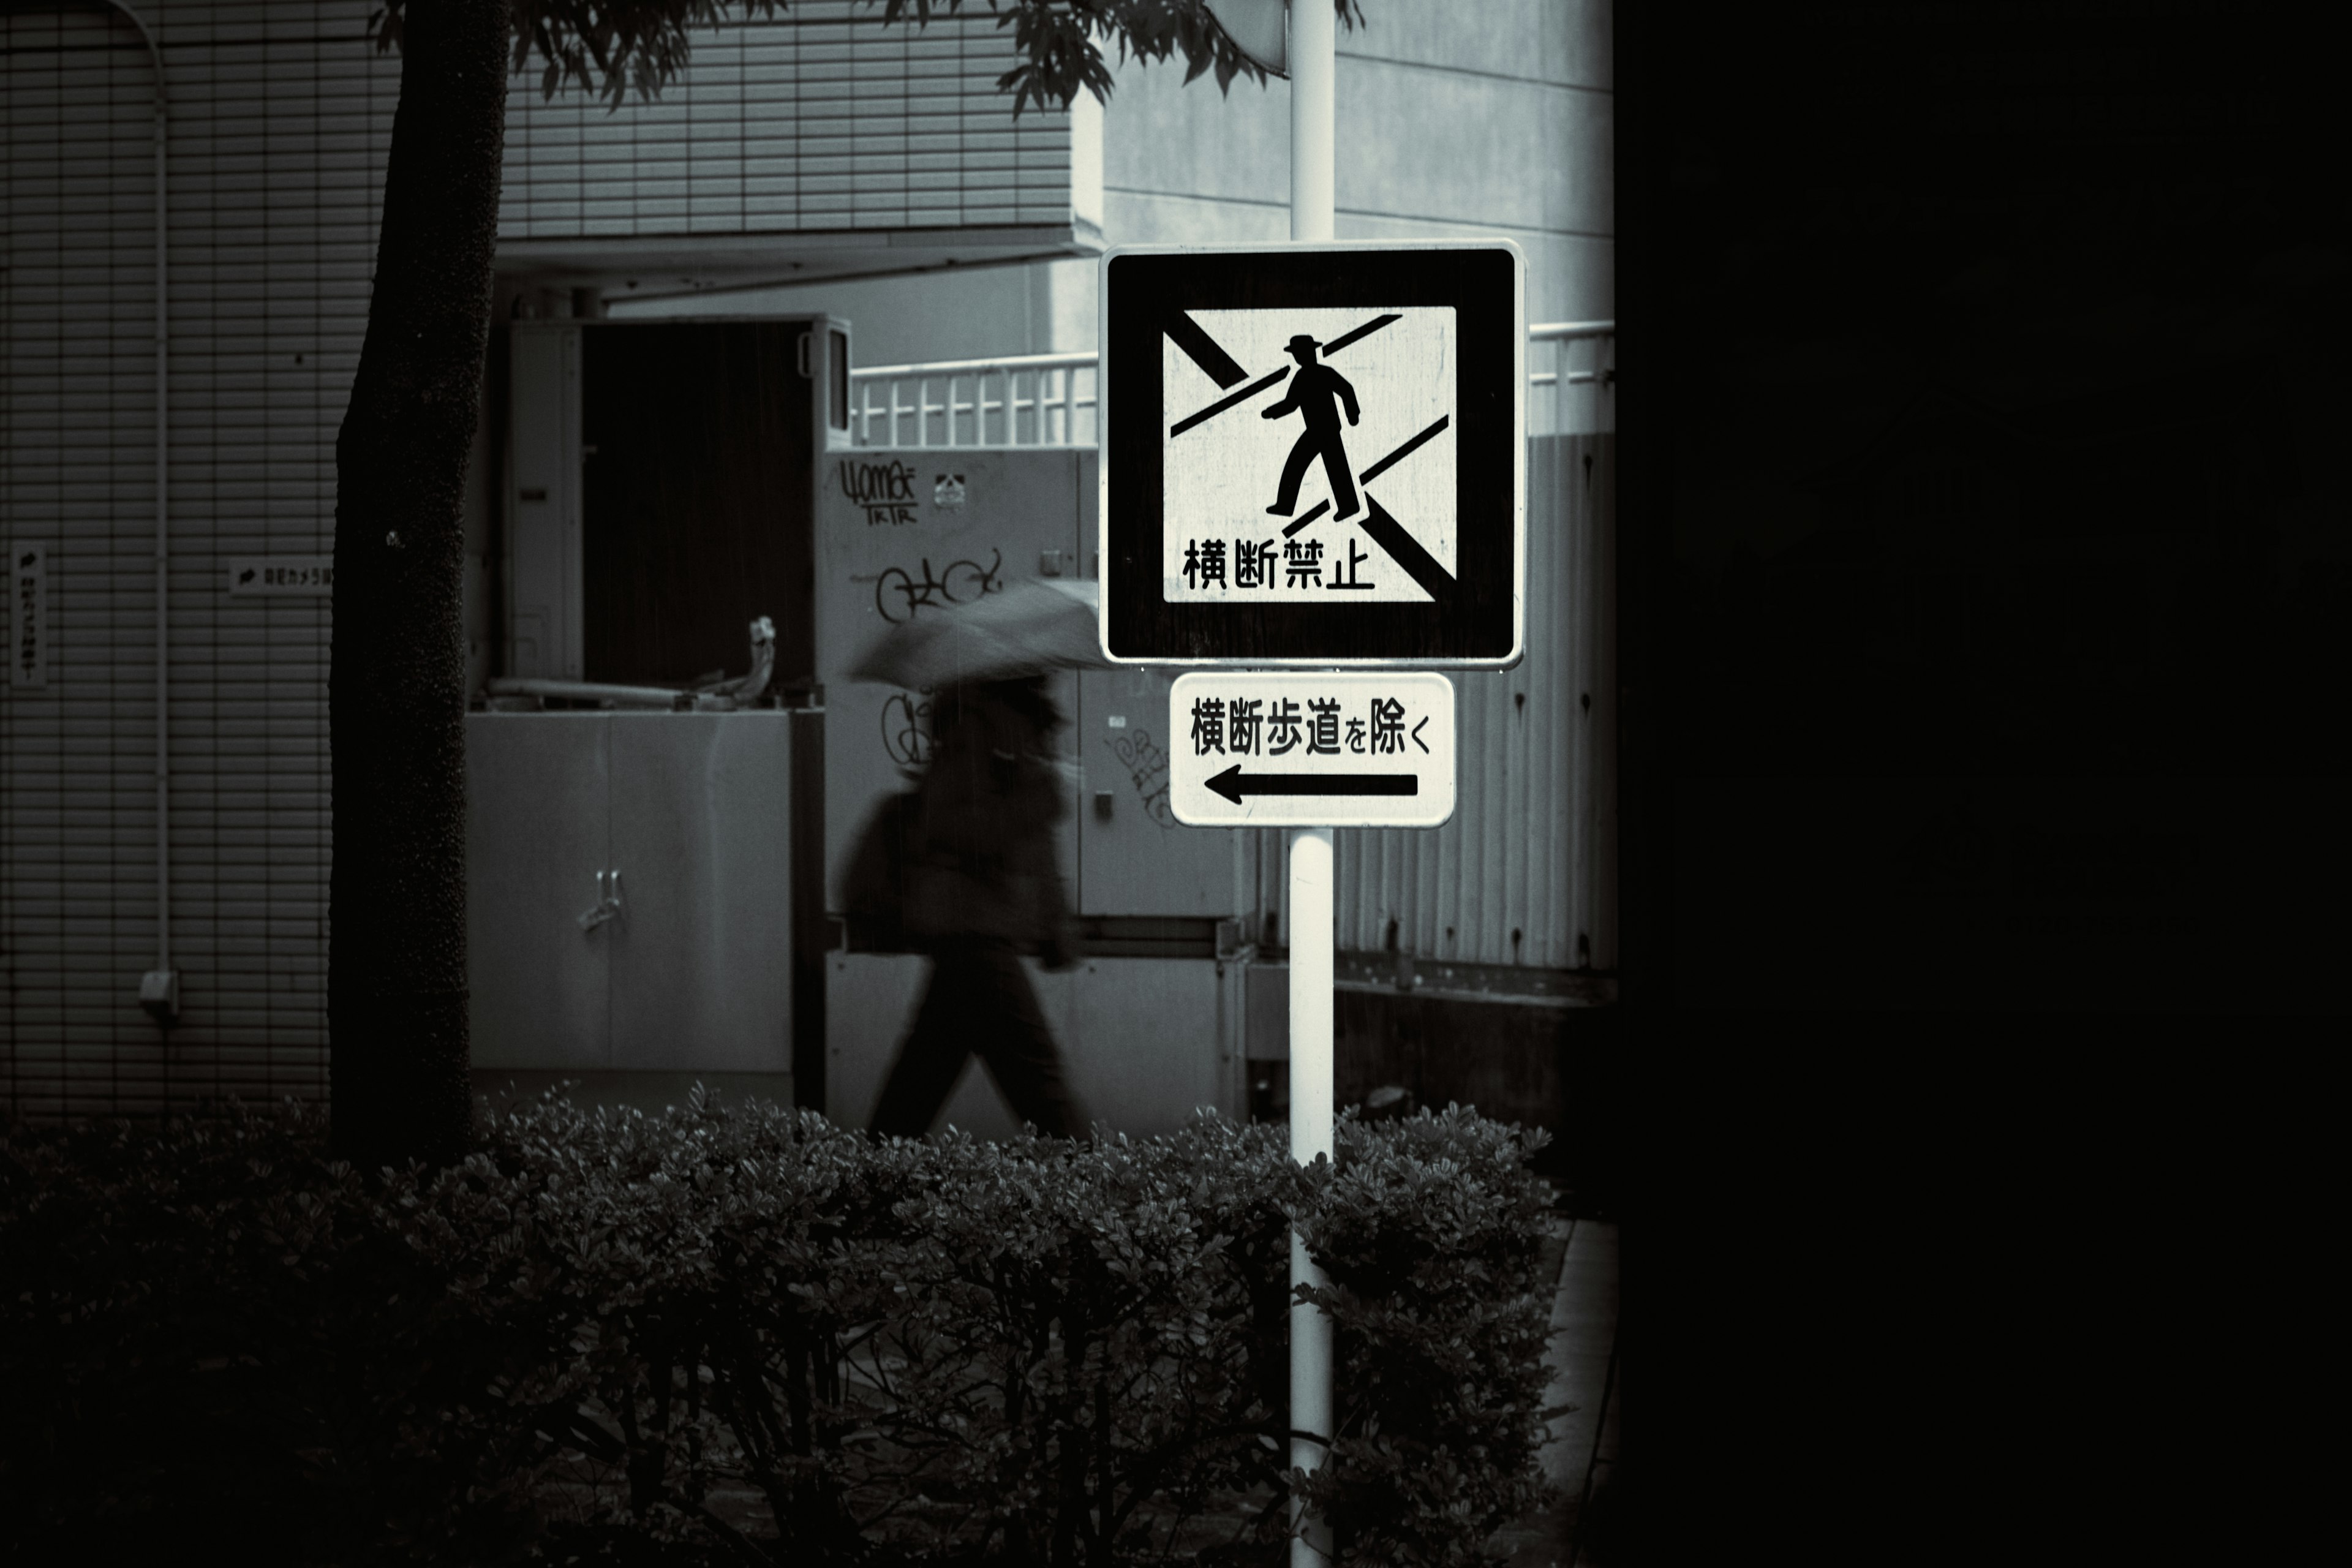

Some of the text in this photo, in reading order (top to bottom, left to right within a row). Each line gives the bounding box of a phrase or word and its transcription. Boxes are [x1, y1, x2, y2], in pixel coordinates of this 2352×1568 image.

[1183, 539, 1375, 589] 横断禁止
[1191, 697, 1429, 755] 横断歩道を除く
